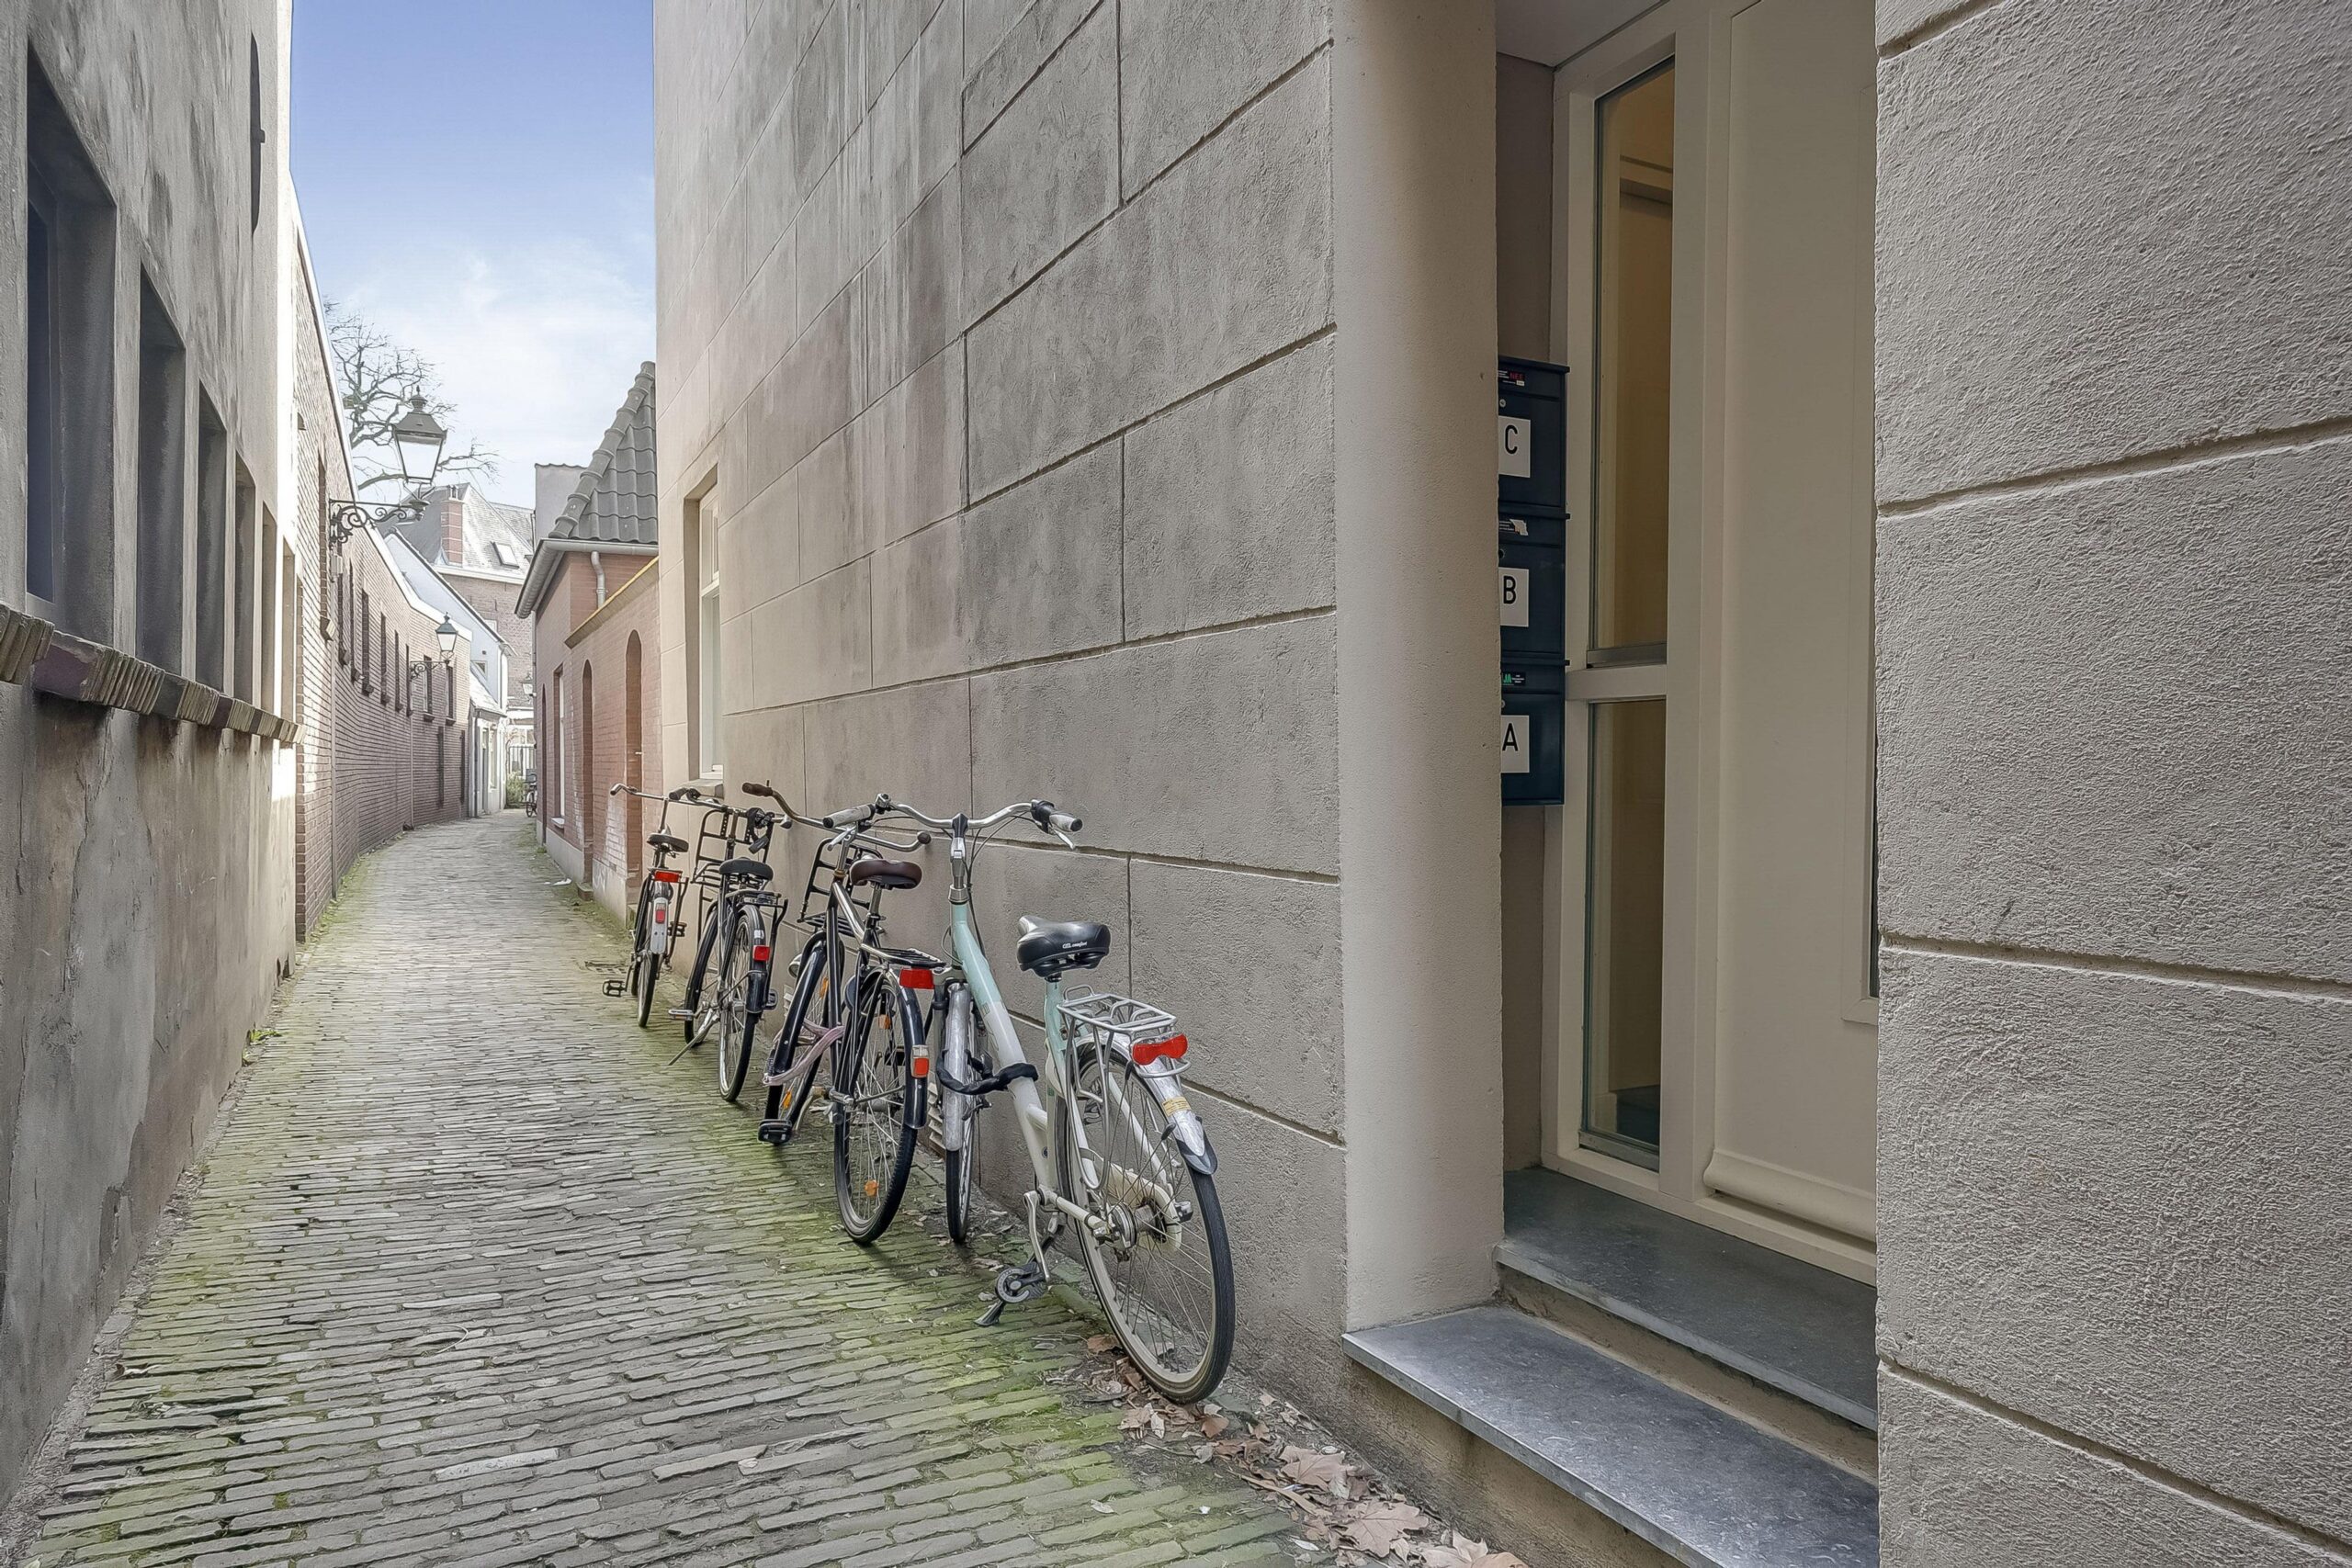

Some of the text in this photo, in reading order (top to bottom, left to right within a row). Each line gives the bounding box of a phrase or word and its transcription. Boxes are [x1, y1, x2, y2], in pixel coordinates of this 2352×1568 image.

[1505, 425, 1518, 454] C
[1503, 575, 1516, 604] B
[1502, 722, 1519, 751] A
